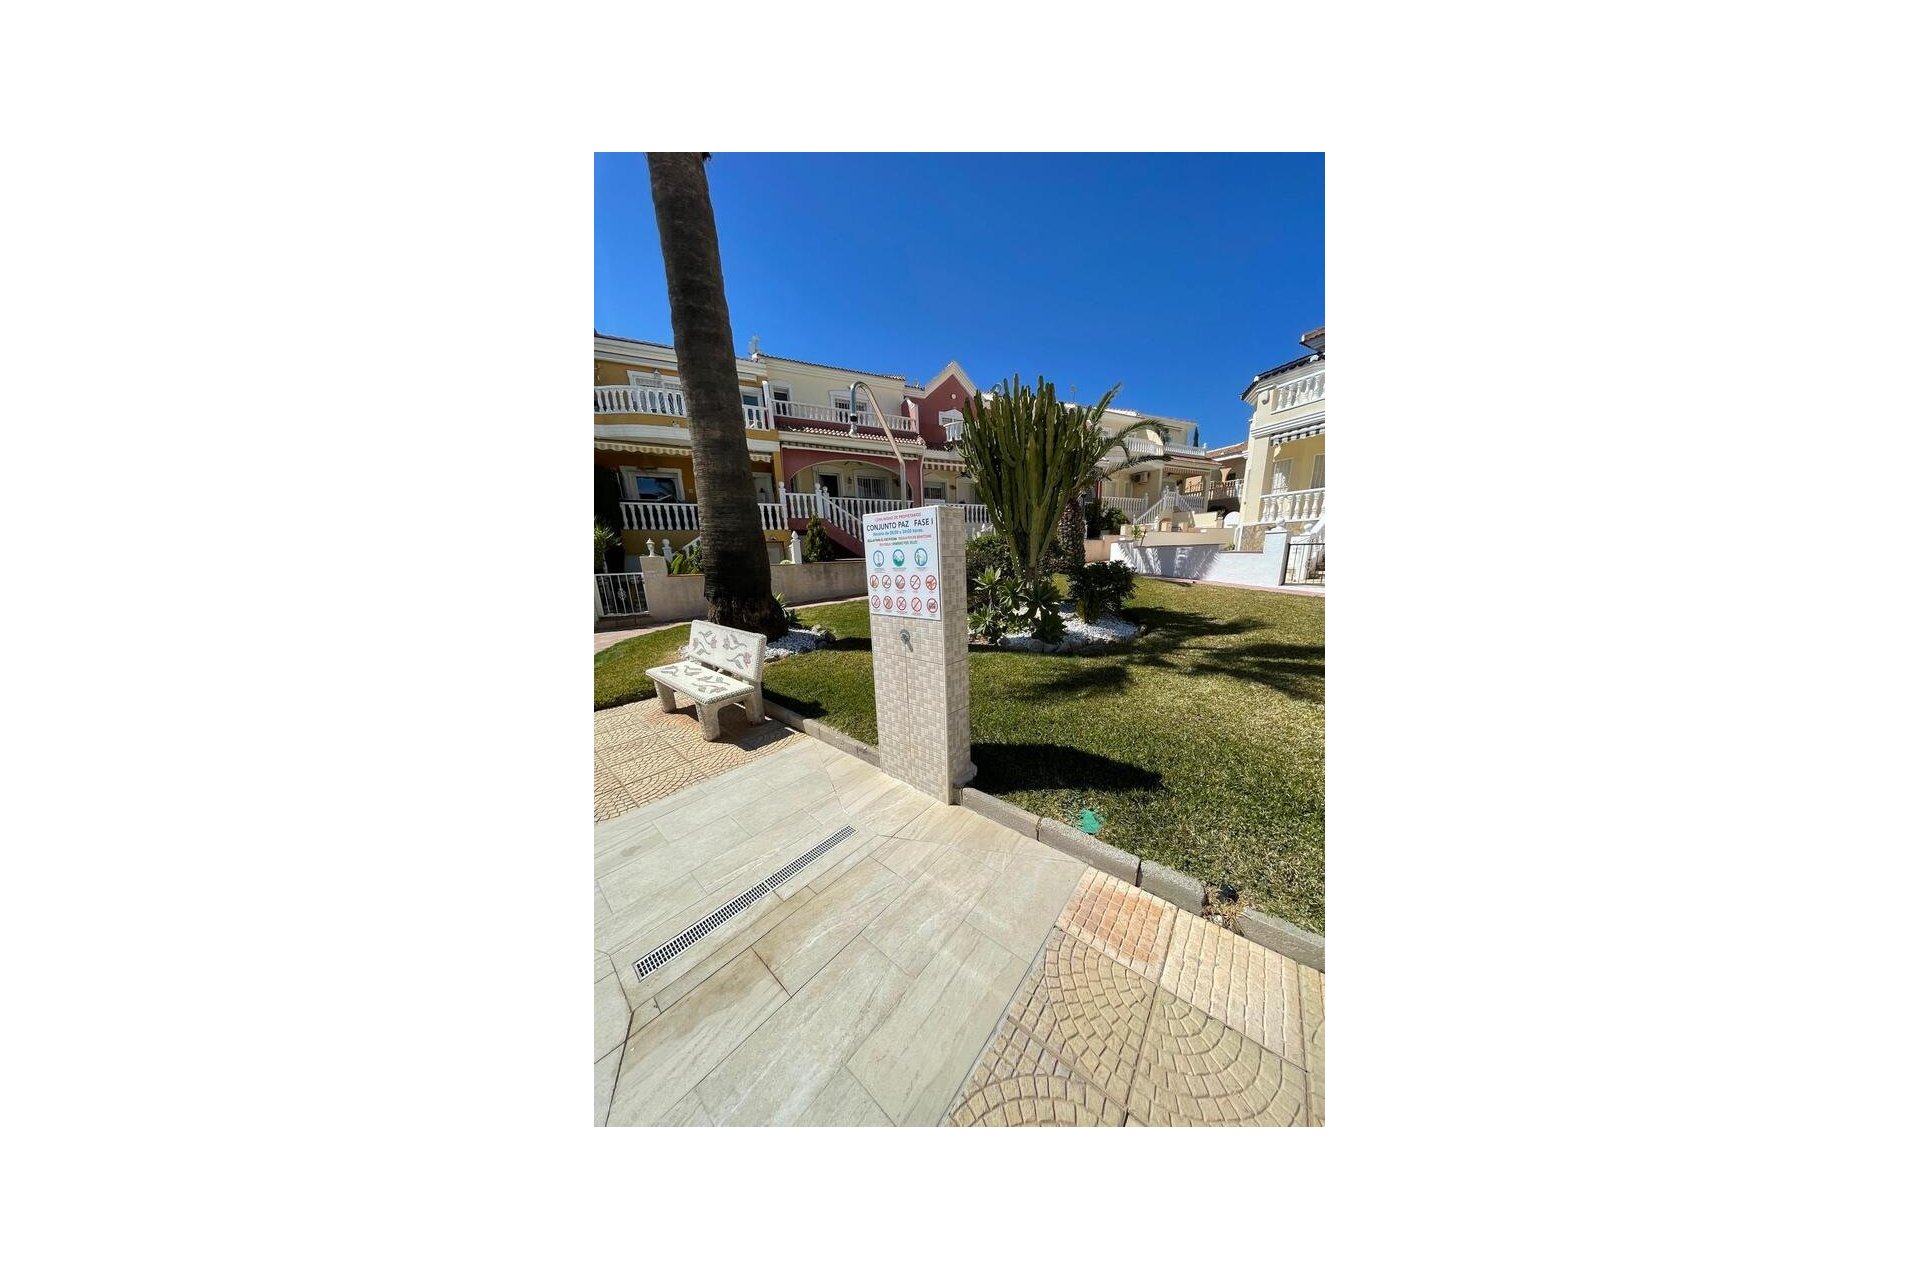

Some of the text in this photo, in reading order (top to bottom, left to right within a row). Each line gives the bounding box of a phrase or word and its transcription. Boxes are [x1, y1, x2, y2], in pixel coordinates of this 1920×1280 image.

[866, 521, 896, 532] CONJUNTO
[898, 520, 909, 529] PAZ
[914, 518, 929, 527] FASE
